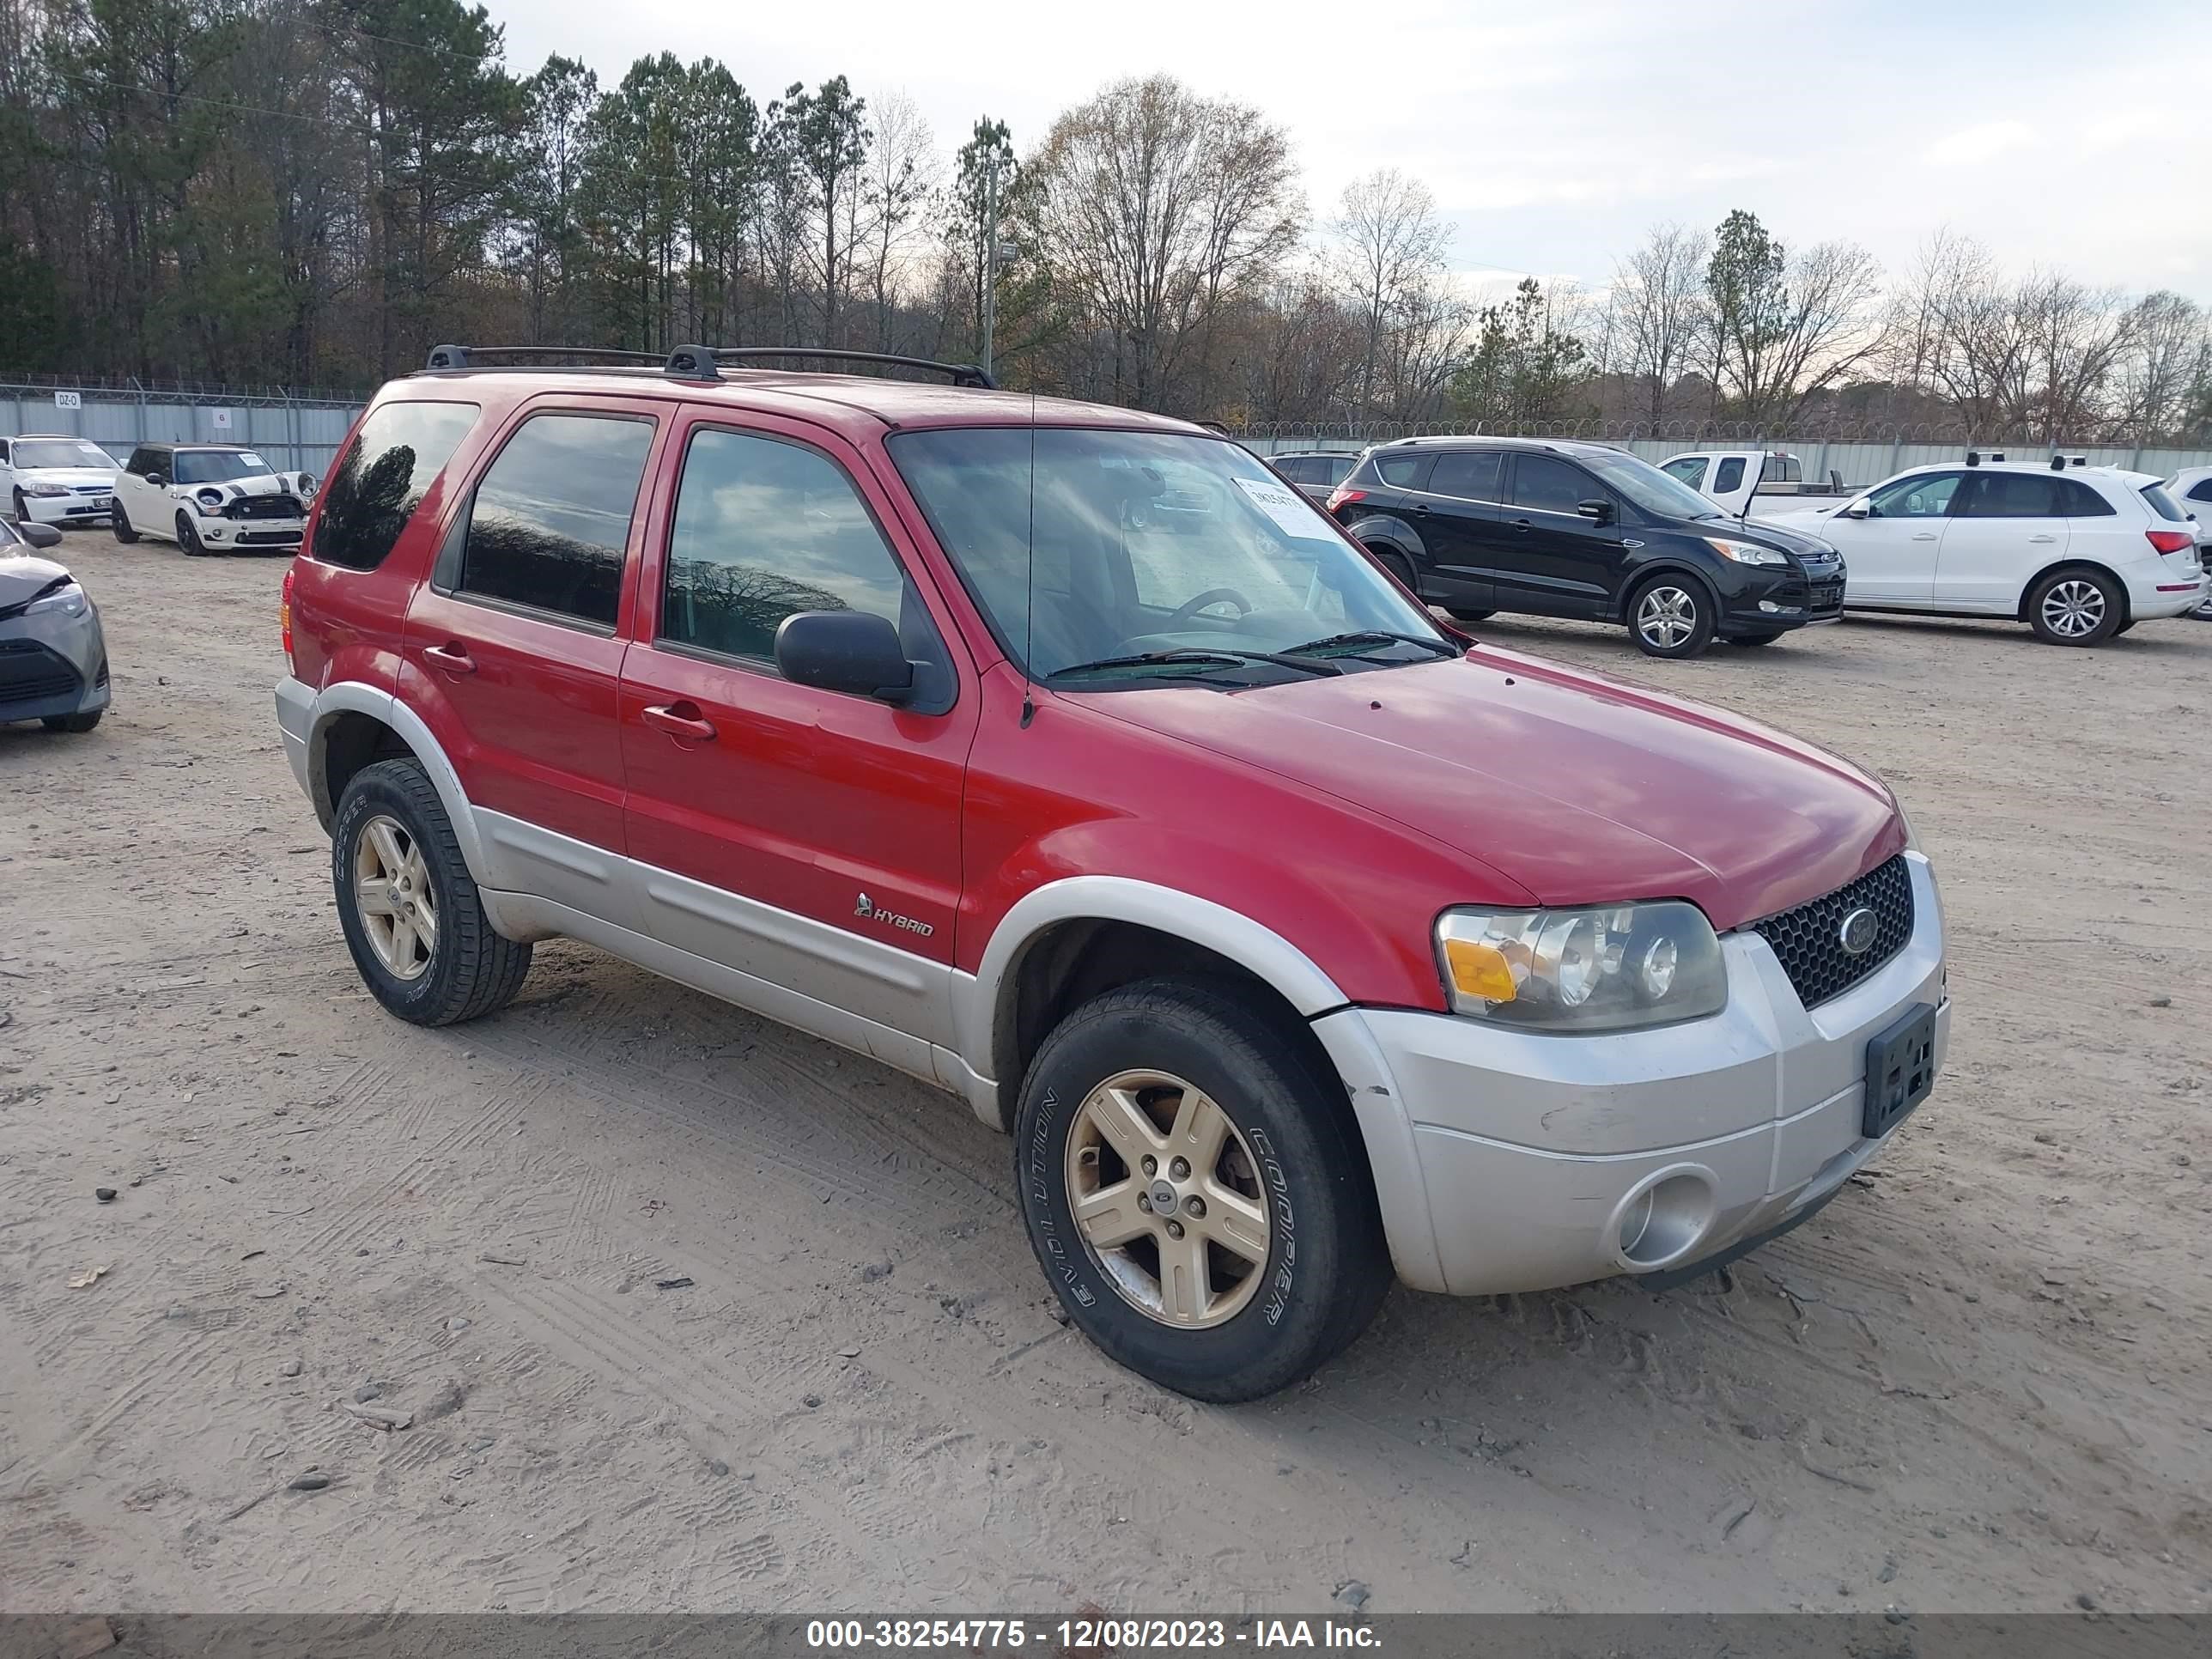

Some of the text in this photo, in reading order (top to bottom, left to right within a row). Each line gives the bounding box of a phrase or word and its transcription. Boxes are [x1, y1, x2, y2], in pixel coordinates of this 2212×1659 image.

[873, 908, 934, 937] HYBRID
[1030, 1085, 1097, 1308] EVOLUTION
[1249, 1127, 1296, 1327] COOPER
